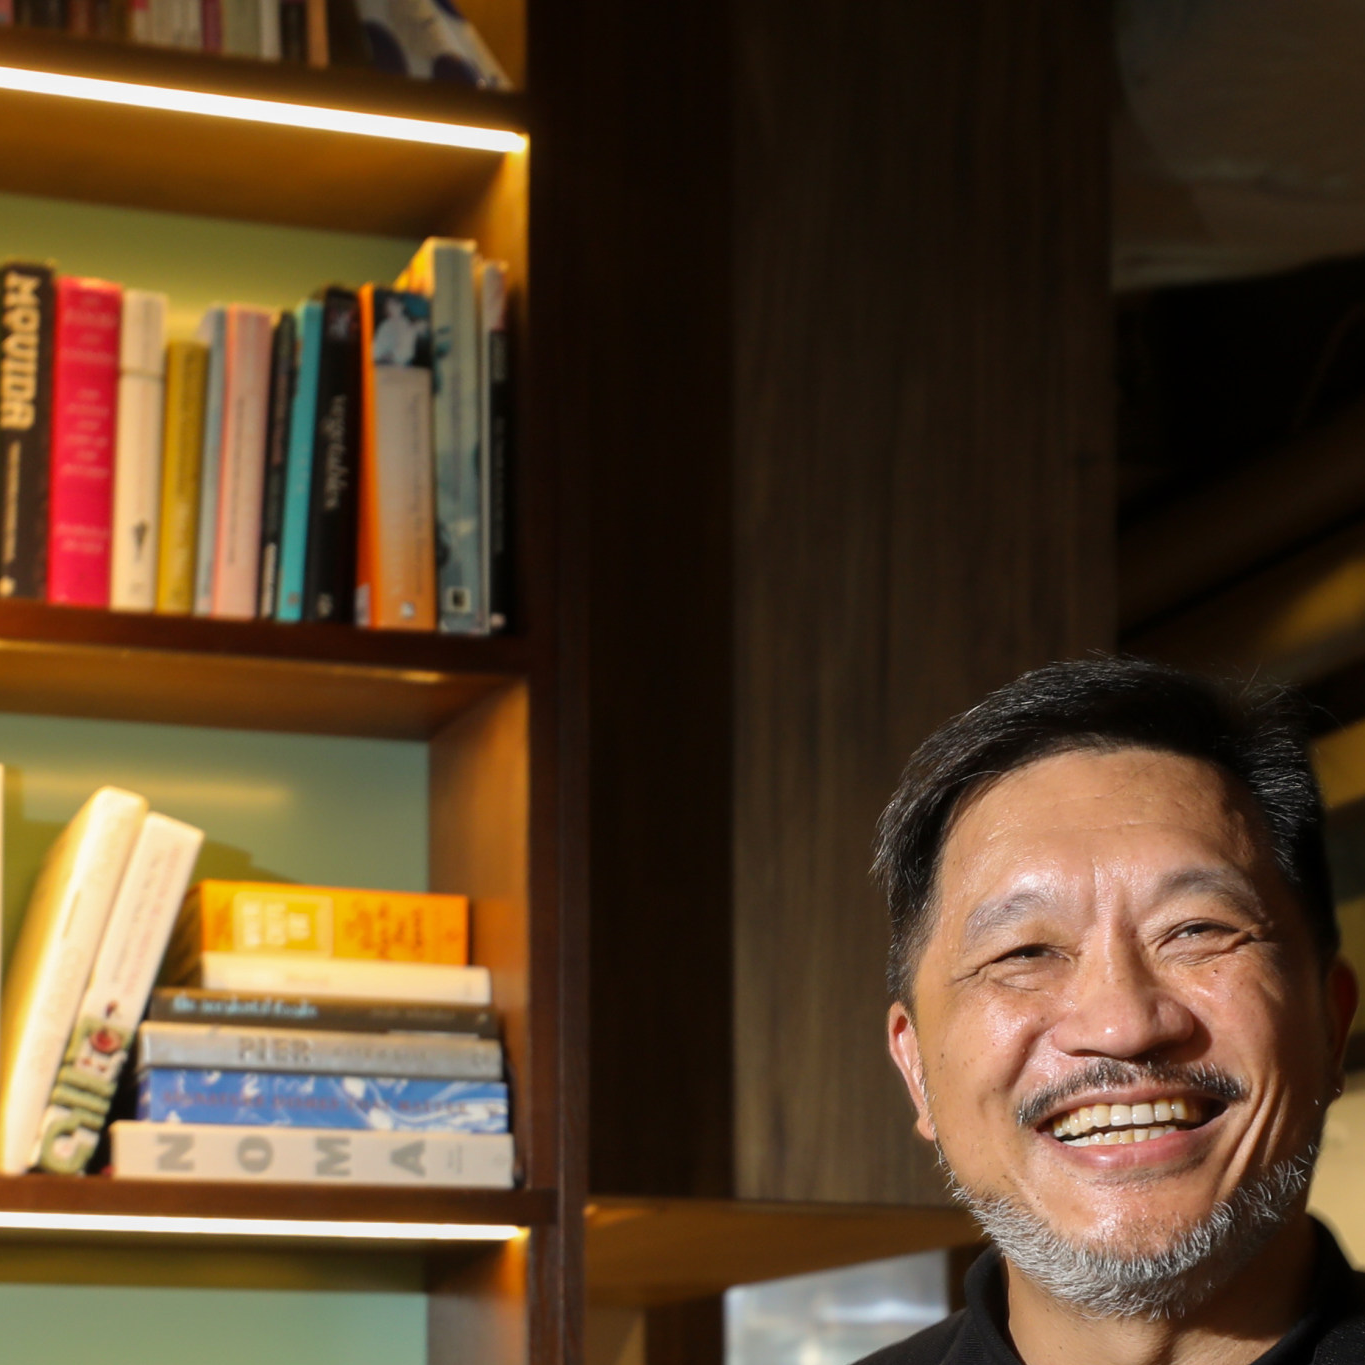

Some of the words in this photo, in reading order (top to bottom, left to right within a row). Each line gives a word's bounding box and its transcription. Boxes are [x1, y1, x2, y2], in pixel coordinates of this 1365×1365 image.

[0, 271, 42, 431] MOVIDA
[320, 395, 349, 511] vegetables
[238, 1036, 314, 1063] PIER
[155, 1134, 427, 1177] NOMA
